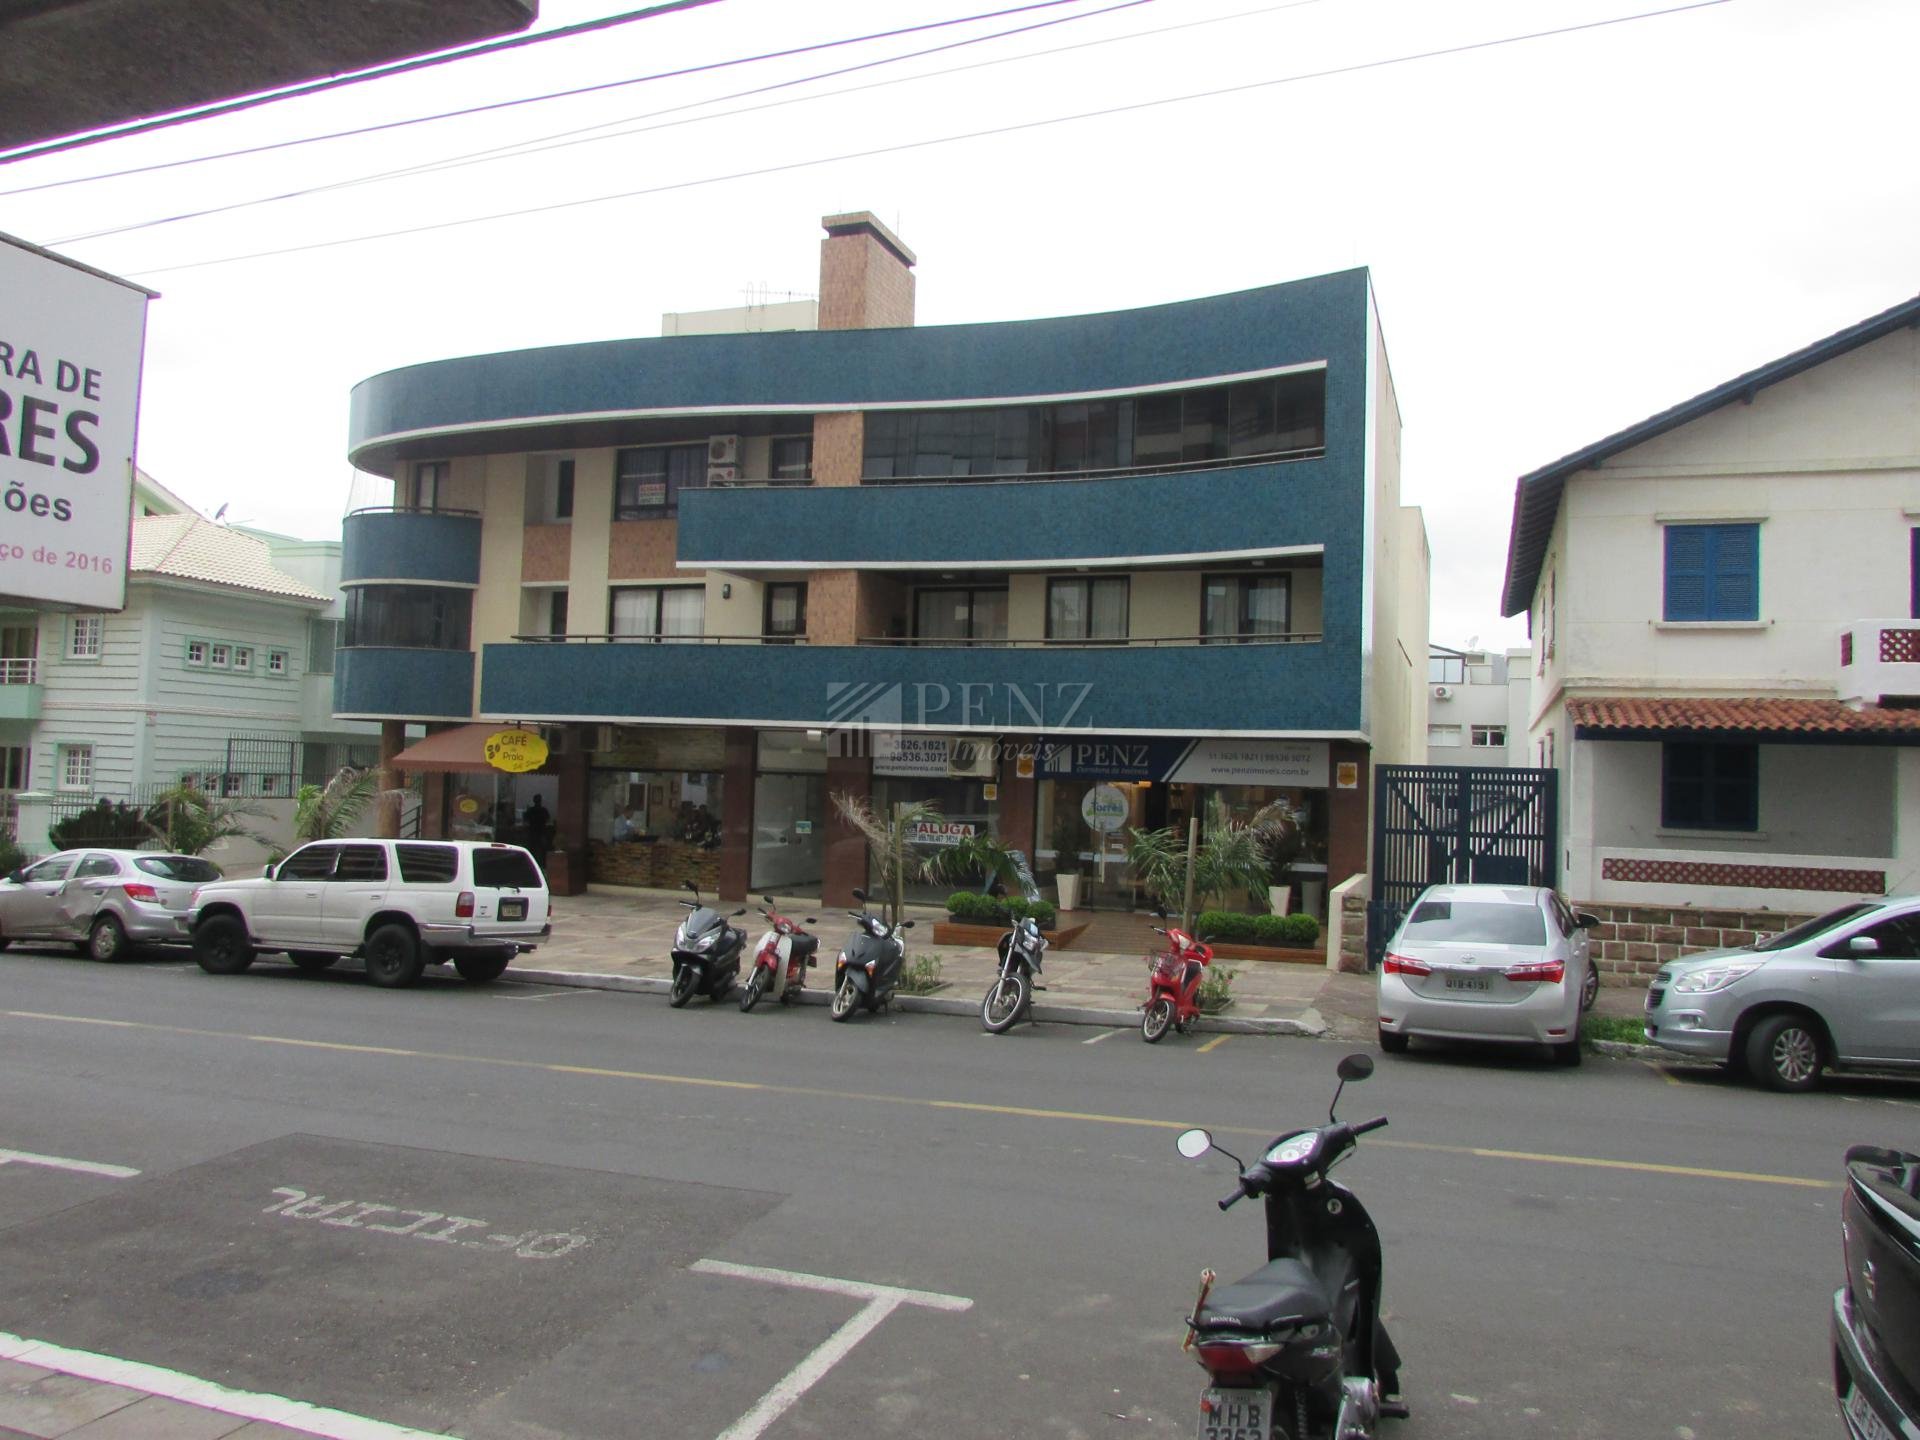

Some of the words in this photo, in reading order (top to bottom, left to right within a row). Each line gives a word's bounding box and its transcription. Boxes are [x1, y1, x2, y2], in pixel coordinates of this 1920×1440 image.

[57, 359, 102, 402] DE
[0, 481, 72, 522] ões
[32, 546, 57, 565] de
[65, 551, 112, 574] 2016
[501, 733, 527, 746] CAFÉ
[894, 740, 946, 750] 3626.1821
[1075, 744, 1149, 767] PENZ
[918, 823, 972, 836] ALUGA
[1210, 1316, 1241, 1325] HONDA
[1208, 1404, 1261, 1428] MHB
